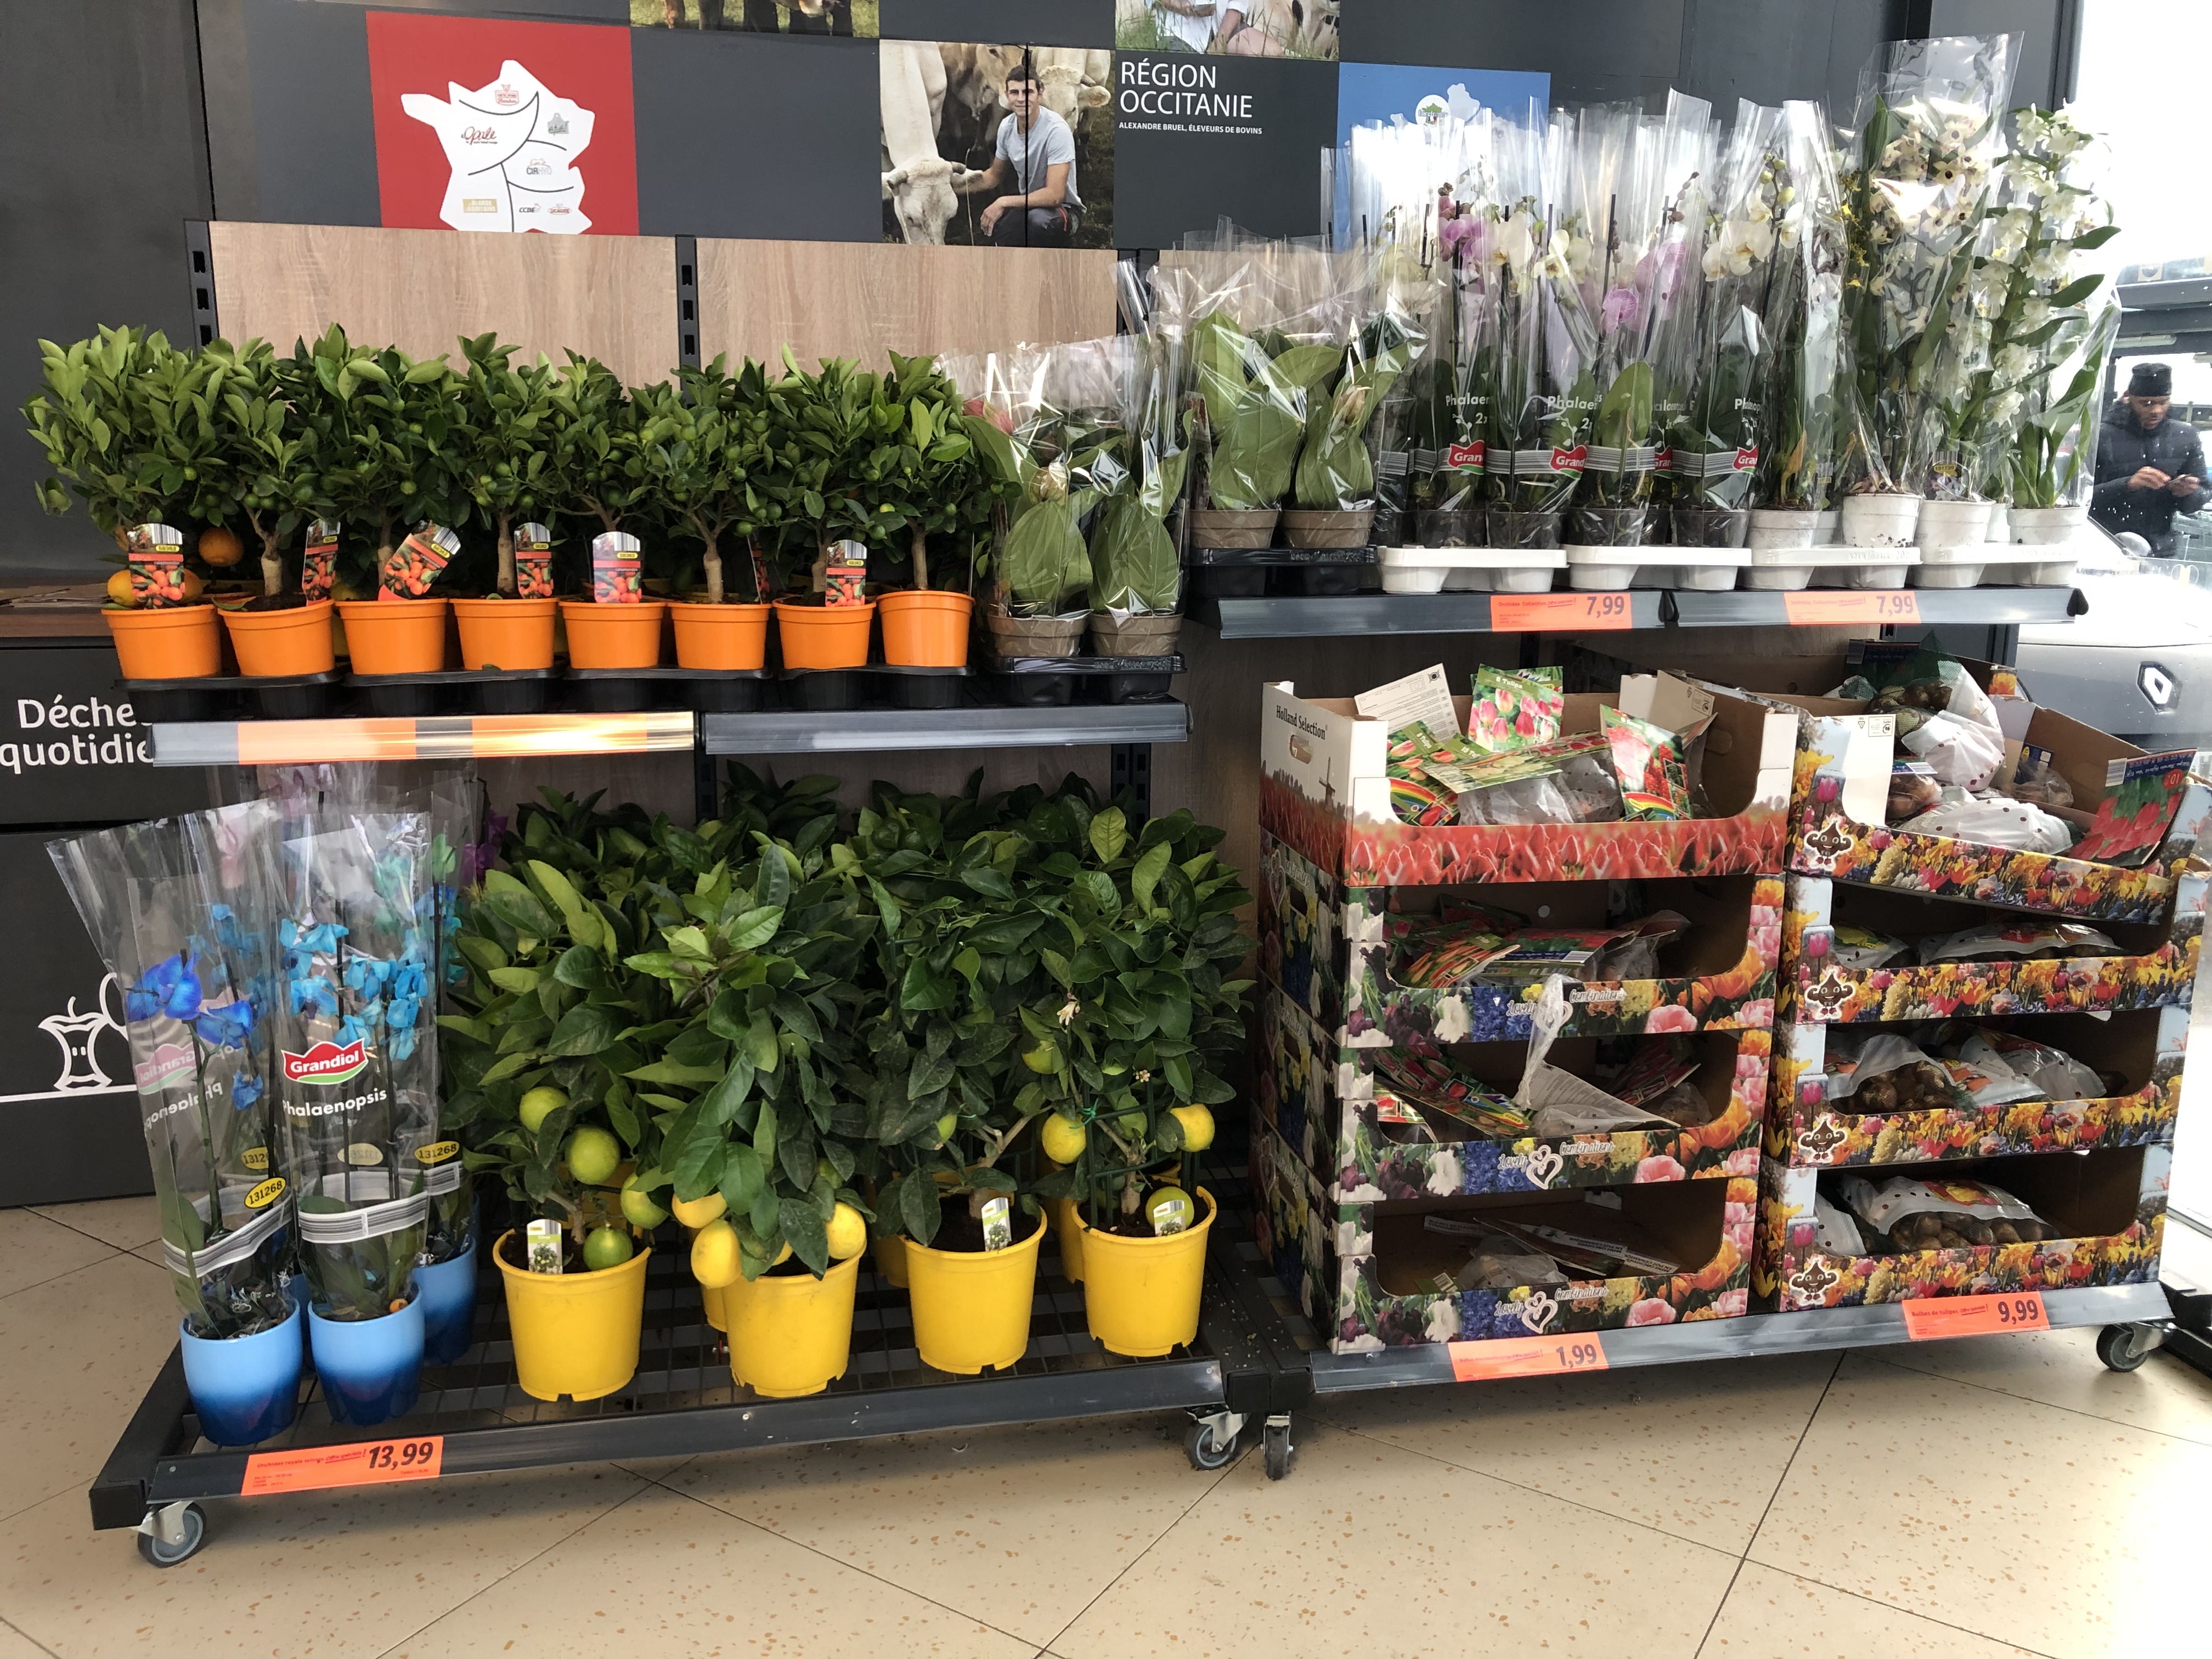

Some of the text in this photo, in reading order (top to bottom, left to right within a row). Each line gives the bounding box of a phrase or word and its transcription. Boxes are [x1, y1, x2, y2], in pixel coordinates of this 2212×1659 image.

[1121, 58, 1216, 88] RÉGION
[1120, 89, 1253, 118] OCCITANIE
[1119, 122, 1161, 131] ALEXANDRE
[1163, 123, 1188, 132] BRUEL,
[1188, 122, 1224, 133] ÉLEVEURS
[1454, 452, 1484, 462] Gran
[1587, 595, 1624, 618] 7,99
[1876, 595, 1914, 617] 7,99
[1502, 679, 1523, 689] Tulipa
[18, 693, 153, 729] Déche
[1276, 704, 1325, 740] Holland Selection
[1506, 1000, 1538, 1020] Lovely
[290, 1050, 359, 1073] Grandiol
[283, 1087, 387, 1116] Phalaenopsis
[245, 1153, 269, 1164] 1312
[419, 1144, 458, 1159] 131268
[1497, 1140, 1616, 1173] Lovely Combinations
[249, 1181, 283, 1205] 131268
[1494, 1286, 1609, 1318] Lovely Combinations
[1997, 1300, 2038, 1324] 9,99
[1556, 1344, 1597, 1368] 1,99
[369, 1441, 433, 1470] 13,99
